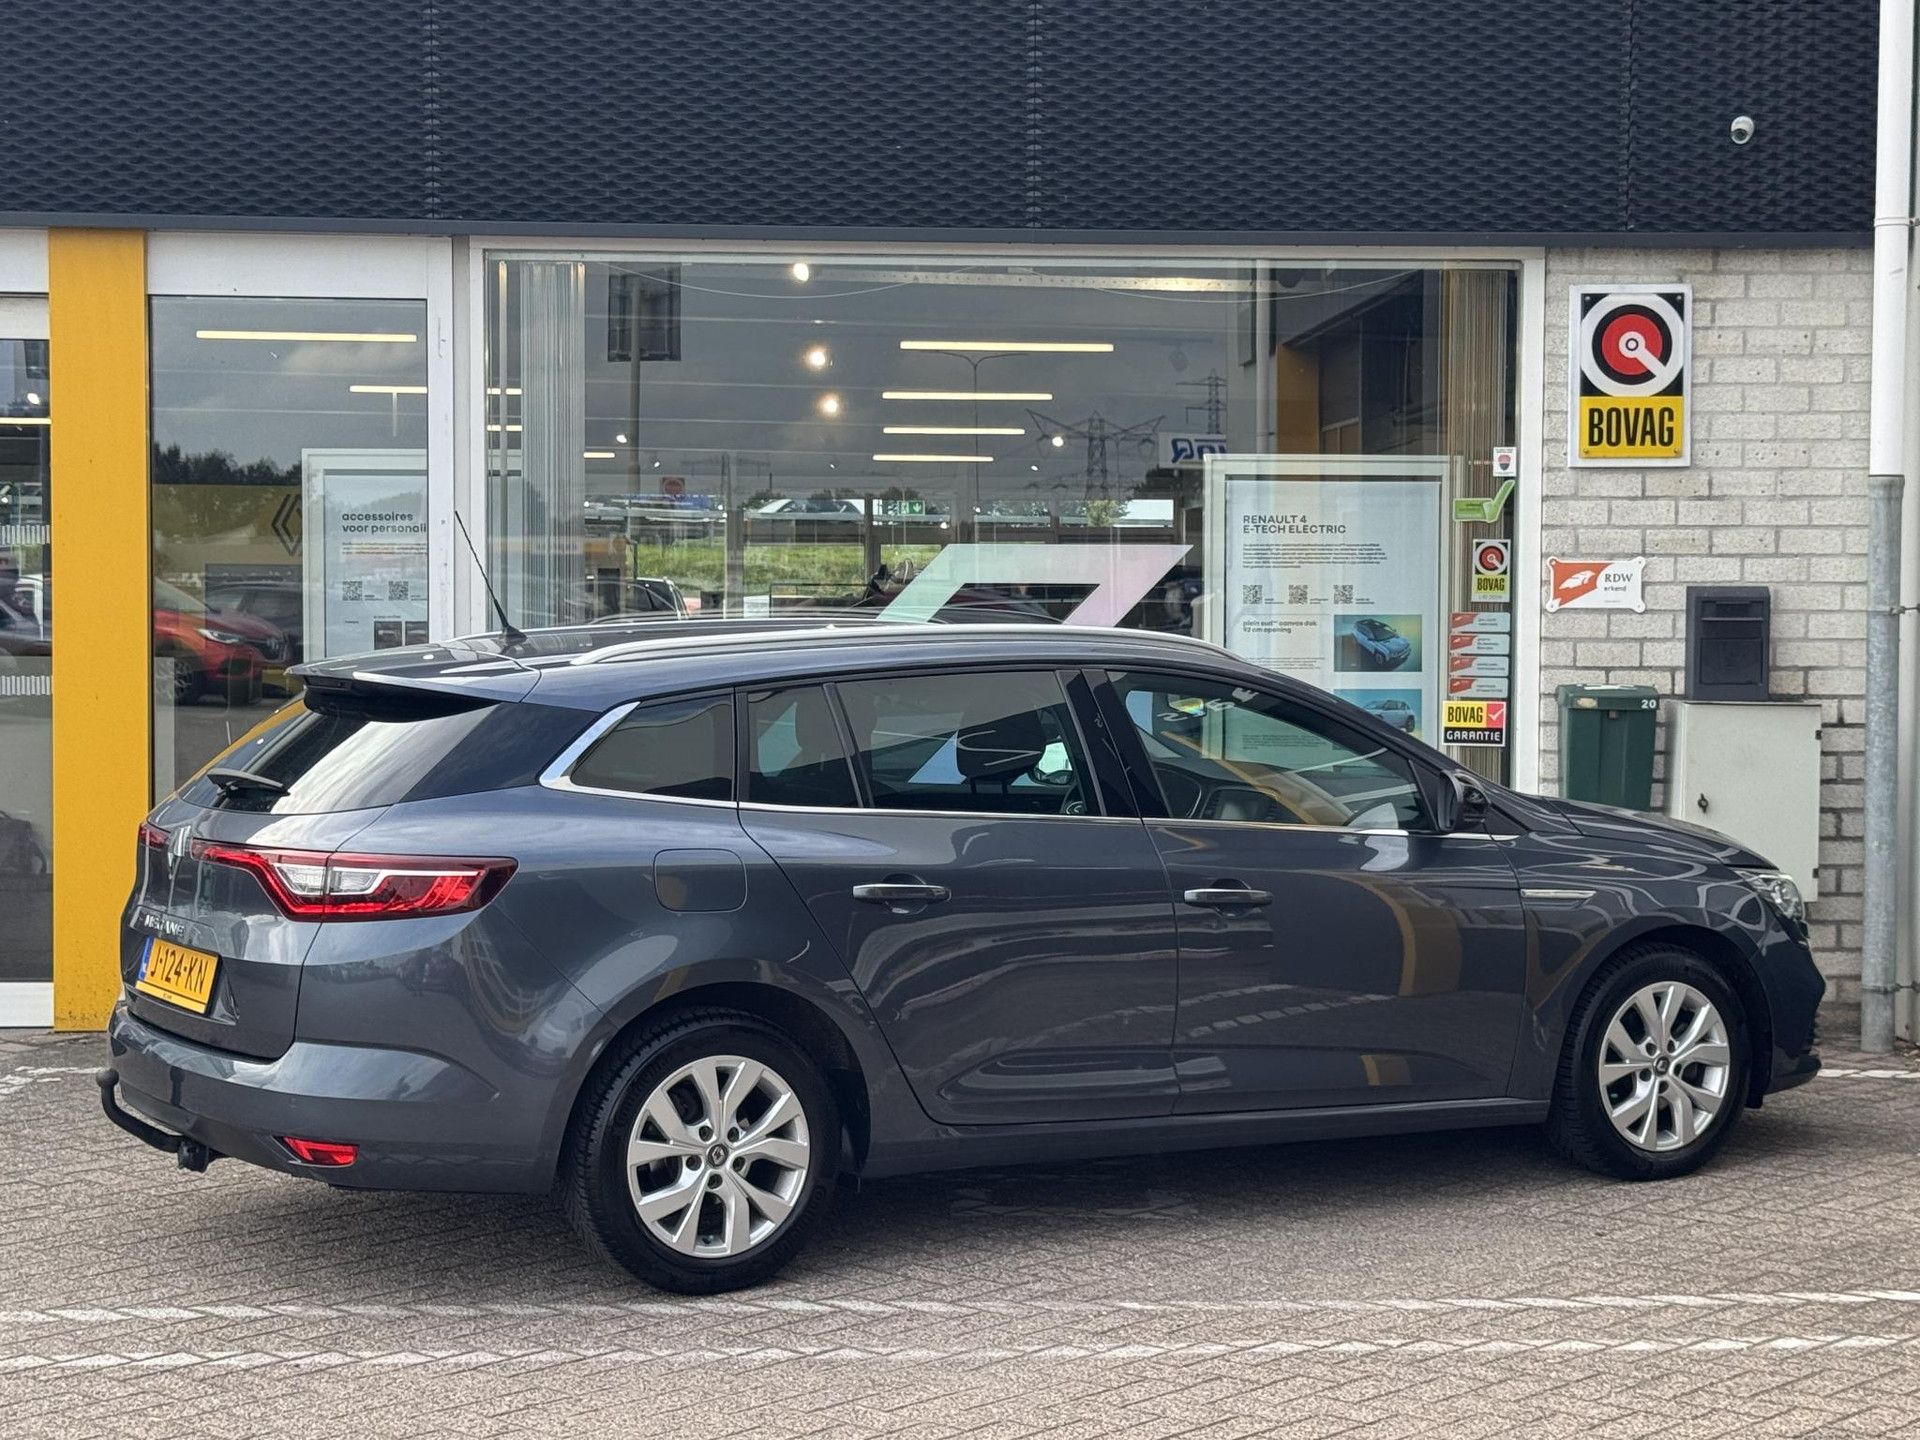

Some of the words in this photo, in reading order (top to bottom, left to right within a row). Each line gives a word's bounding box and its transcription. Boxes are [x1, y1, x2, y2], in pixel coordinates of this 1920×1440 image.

[1588, 406, 1674, 447] BOVAG
[342, 512, 413, 521] accessoires
[1243, 515, 1298, 524] RENAULT
[1299, 515, 1307, 524] 4
[1243, 525, 1286, 534] E-TECH
[1288, 525, 1346, 534] ELECTRIC
[1604, 573, 1633, 583] RDW
[1477, 577, 1505, 591] BOVAG
[1641, 699, 1657, 709] 20
[1447, 706, 1483, 723] BOVAG
[1446, 730, 1501, 741] GARANTIE
